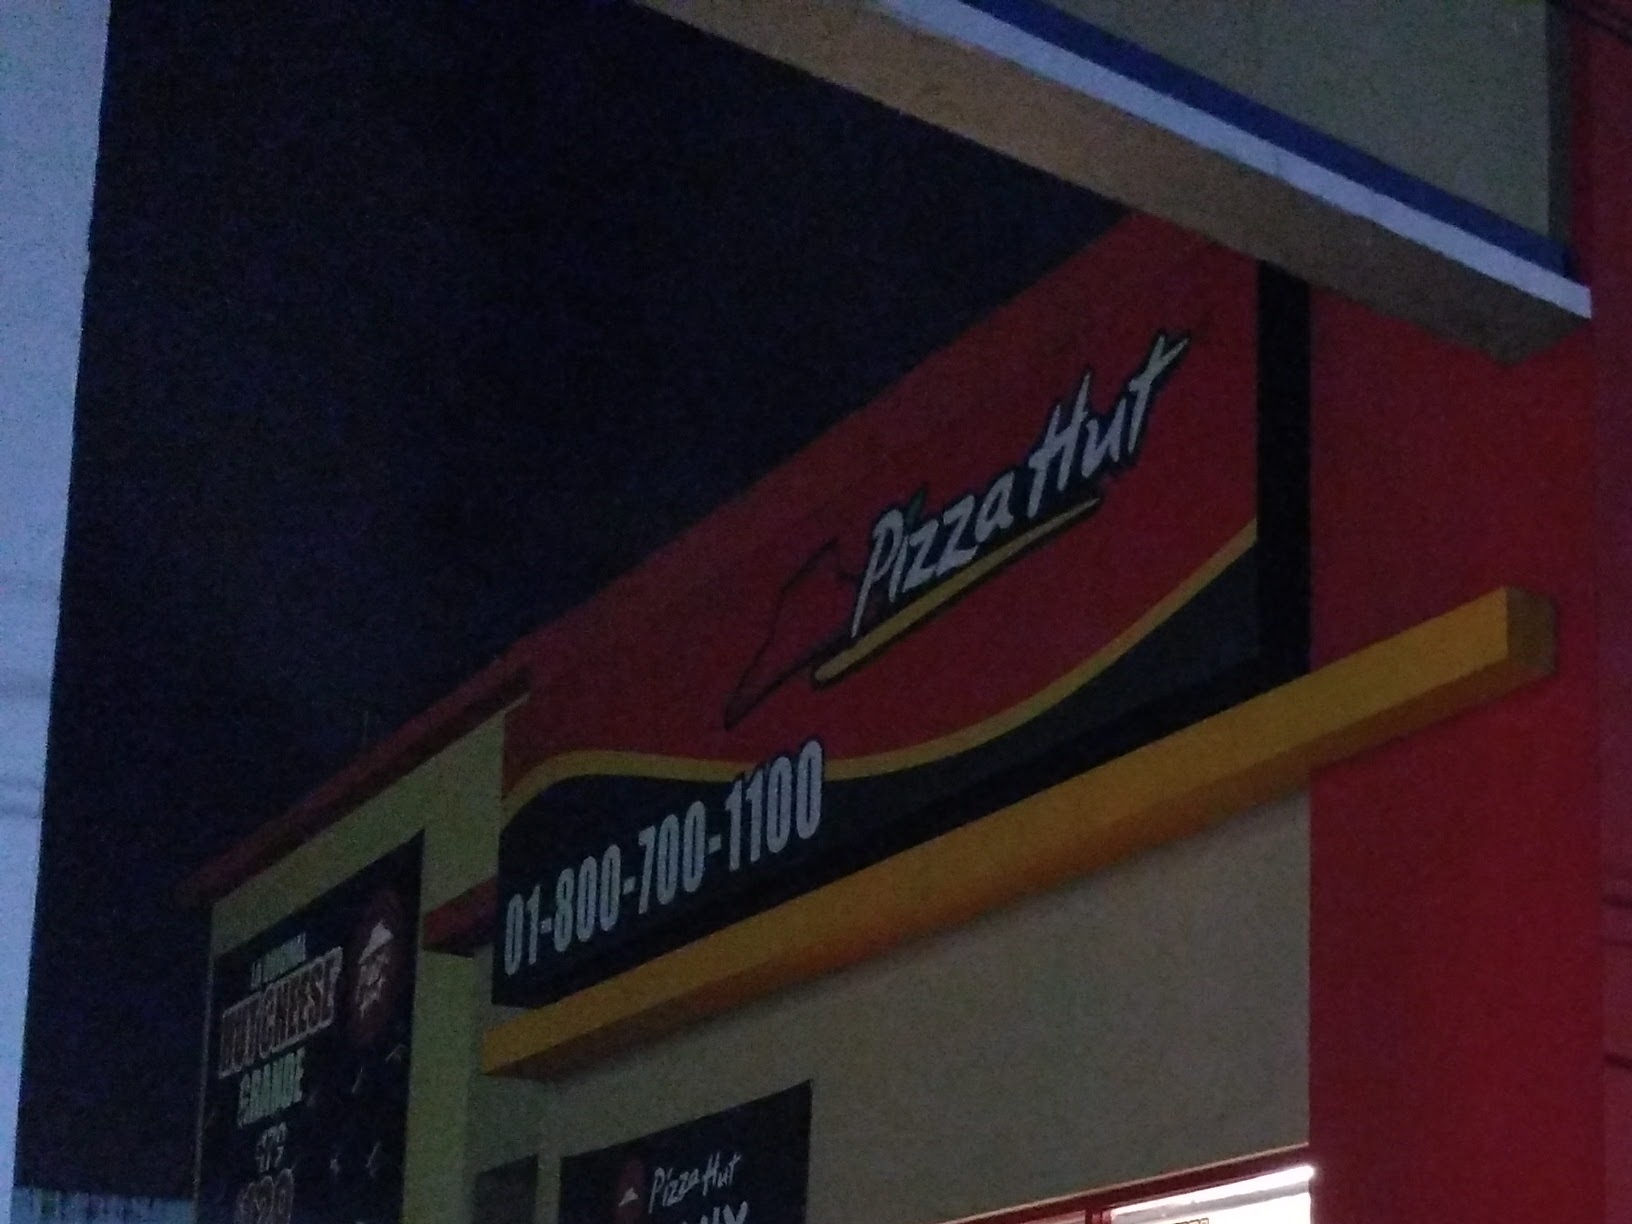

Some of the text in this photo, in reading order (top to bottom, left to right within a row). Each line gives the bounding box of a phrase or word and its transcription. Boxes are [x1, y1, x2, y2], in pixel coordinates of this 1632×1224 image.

[849, 335, 1190, 638] Pizza Hut
[503, 739, 823, 976] 01-800-700-1100
[648, 1151, 742, 1214] Pizza Hut
